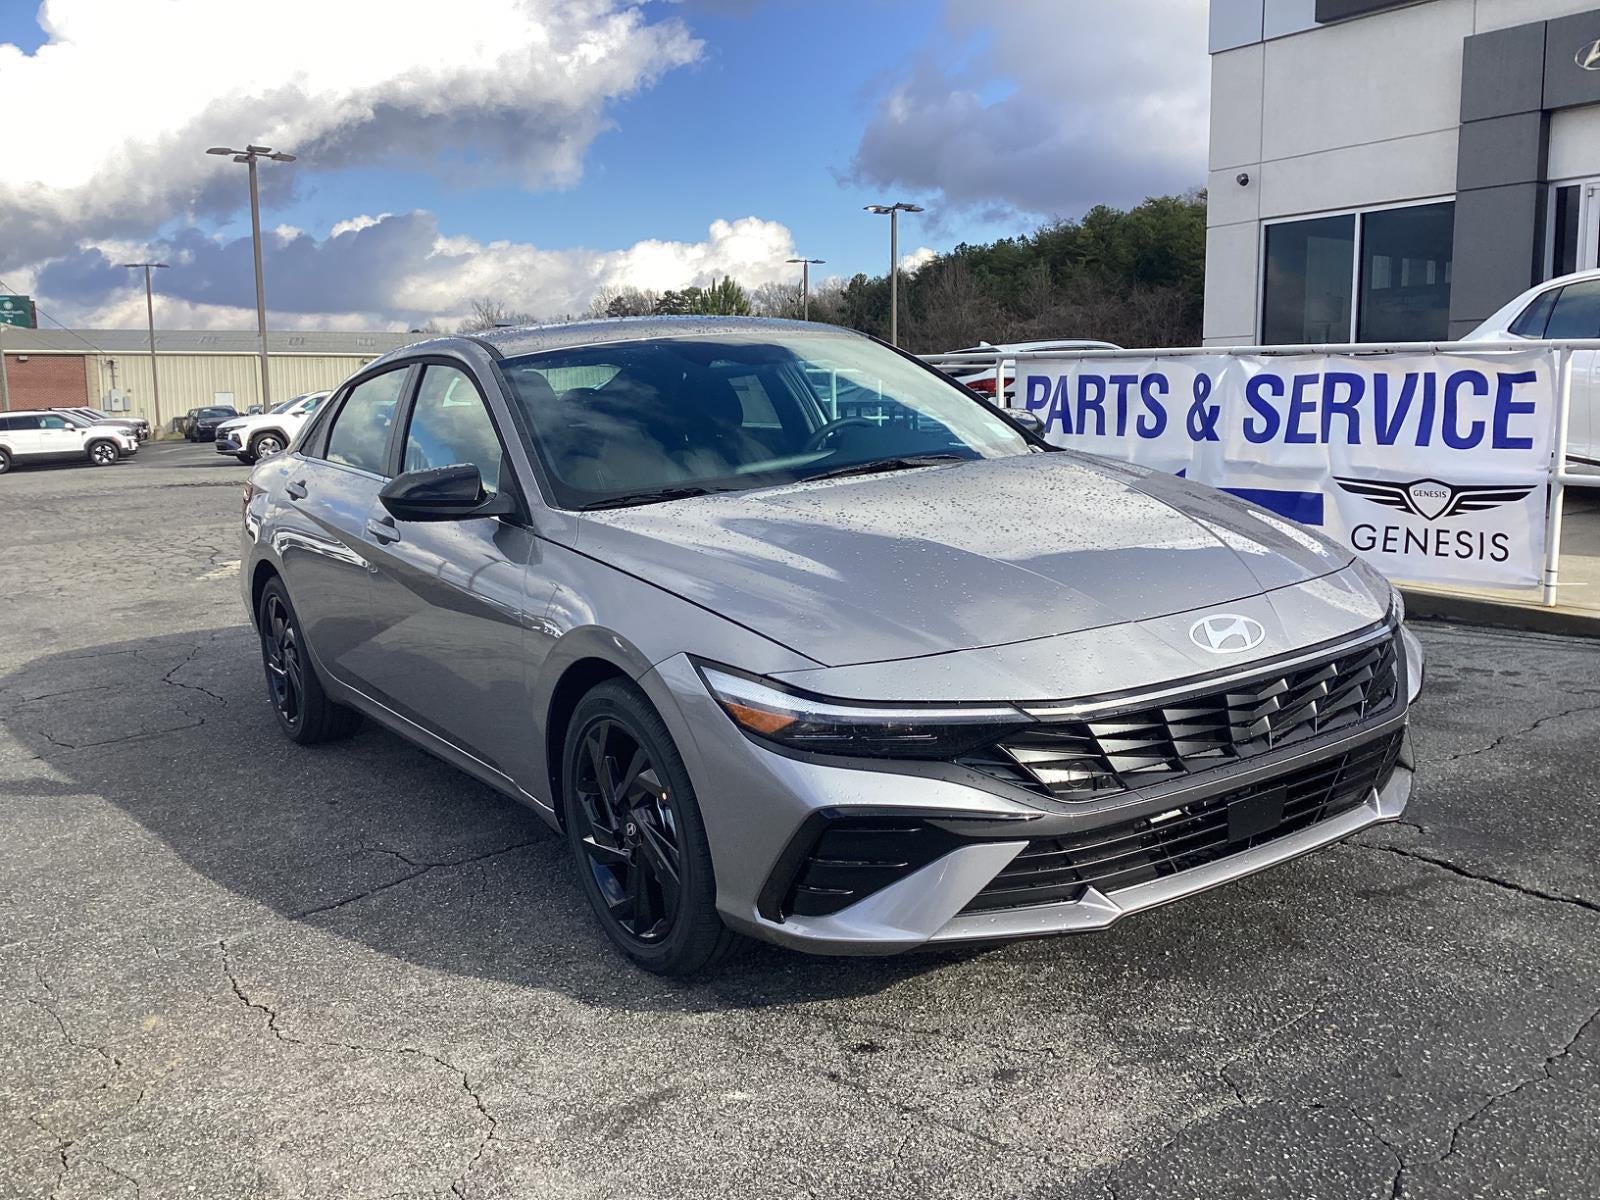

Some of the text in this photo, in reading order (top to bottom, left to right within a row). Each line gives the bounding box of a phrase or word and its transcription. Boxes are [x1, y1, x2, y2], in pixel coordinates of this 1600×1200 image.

[1025, 369, 1536, 450] PARTS & SERVICE
[1413, 489, 1447, 498] GENESIS
[1351, 523, 1509, 562] GENESIS
